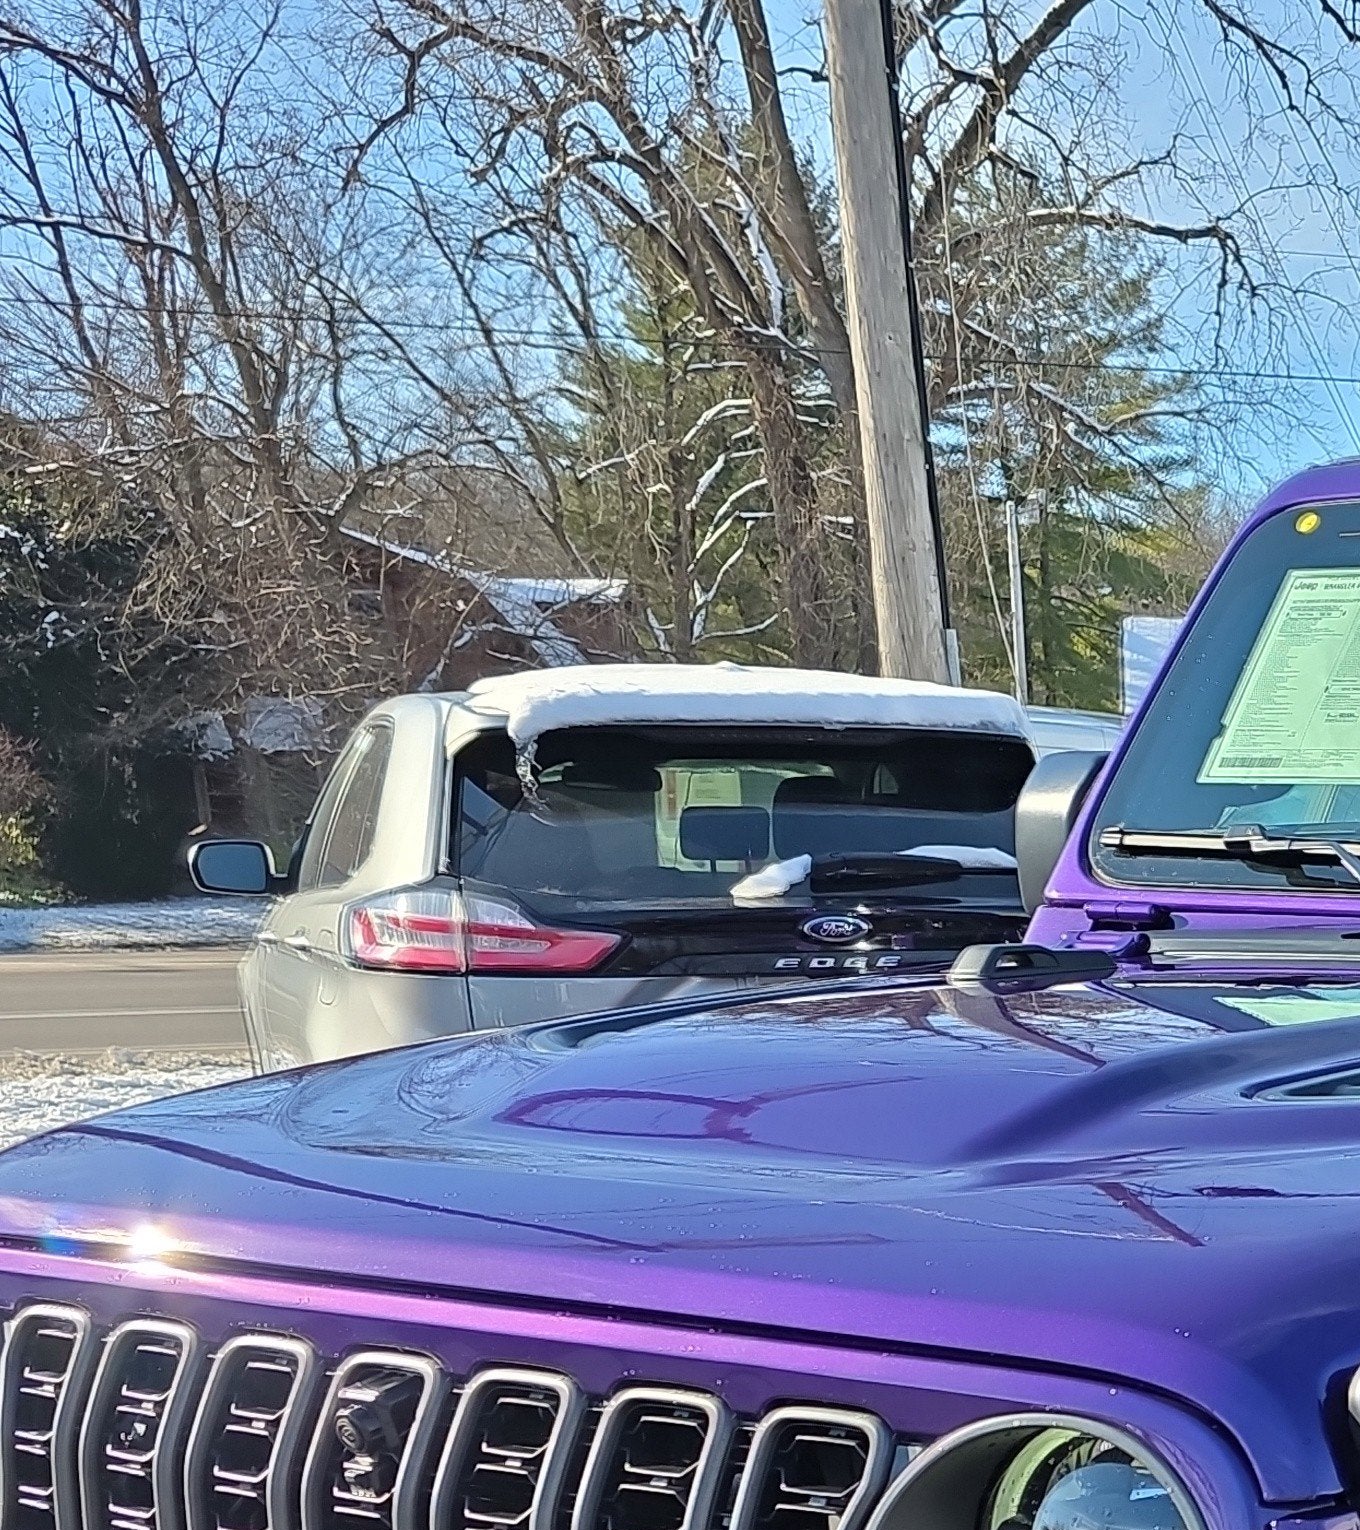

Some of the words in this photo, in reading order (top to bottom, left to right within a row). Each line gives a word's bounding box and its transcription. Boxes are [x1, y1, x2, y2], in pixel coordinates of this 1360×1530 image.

[1294, 581, 1318, 591] Jeep
[820, 921, 855, 936] Ford
[774, 955, 902, 970] EDGE
